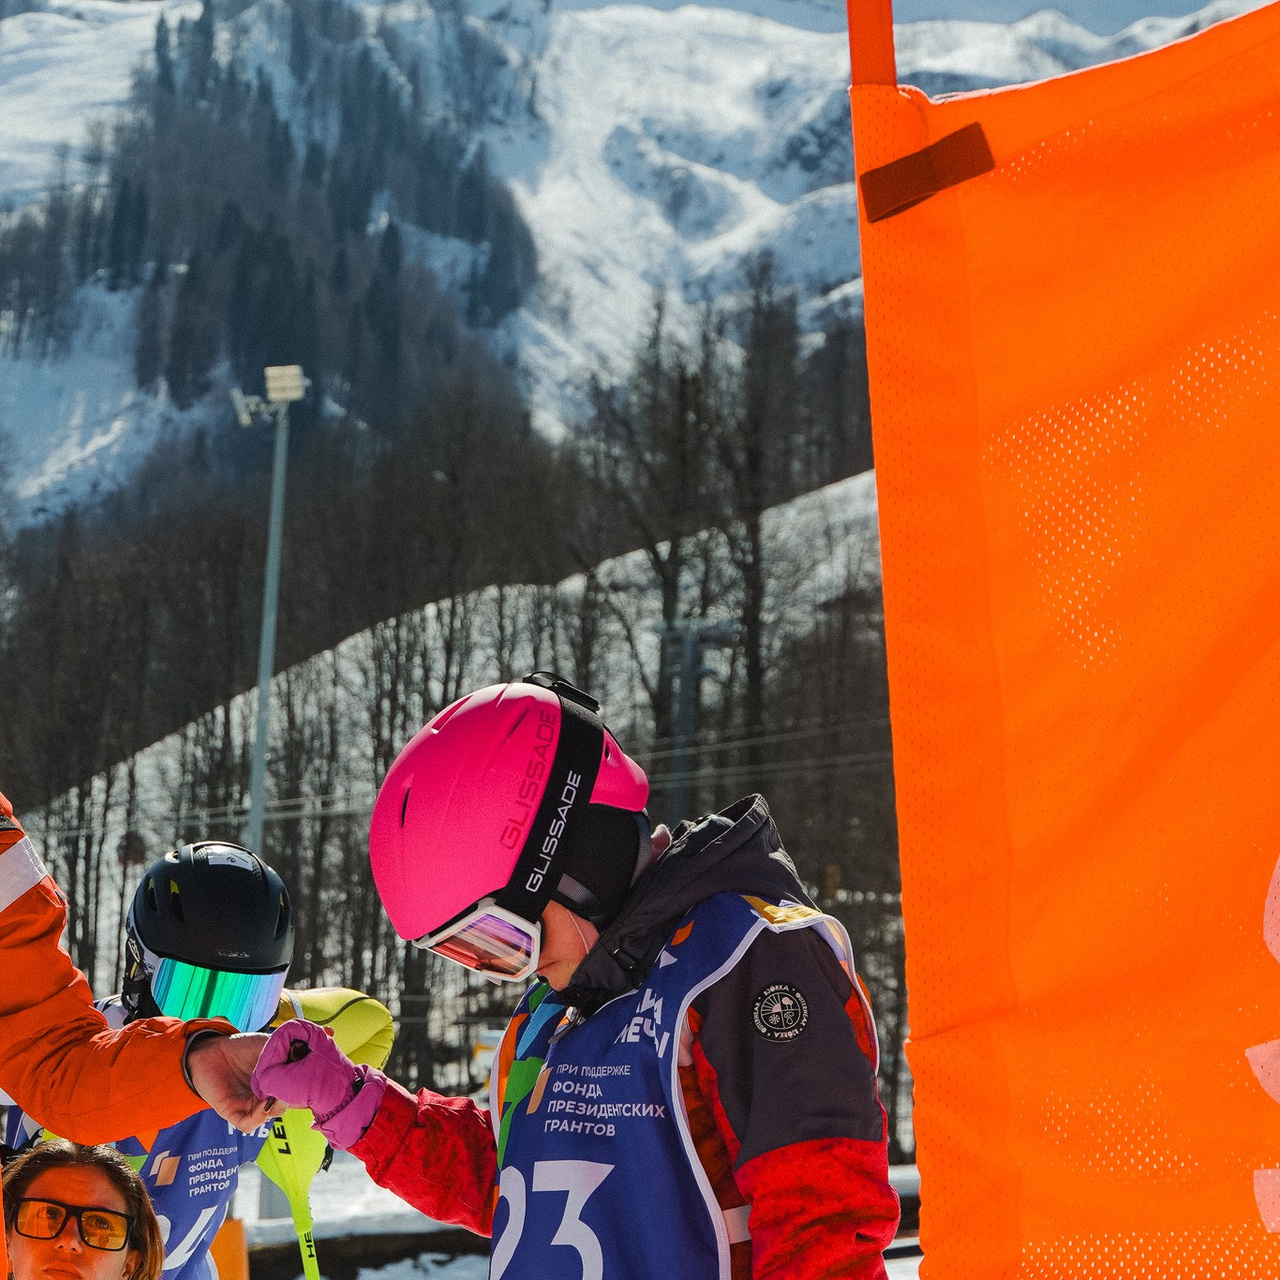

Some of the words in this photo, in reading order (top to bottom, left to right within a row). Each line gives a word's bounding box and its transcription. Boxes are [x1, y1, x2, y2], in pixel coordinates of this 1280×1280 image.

[500, 709, 557, 850] GLISSADE
[525, 770, 581, 893] GLISSADE
[556, 1064, 579, 1076] ПРИ
[581, 1065, 631, 1078] ПОДДЕРЖКЕ
[552, 1080, 603, 1099] ФОНДА
[547, 1100, 665, 1119] ПРЕЗИДЕНТСКИХ
[544, 1119, 616, 1137] ГРАНТОВ
[188, 1152, 202, 1162] ПРИ
[189, 1158, 224, 1173] ФОНДА
[189, 1180, 230, 1198] ГРАНТОВ
